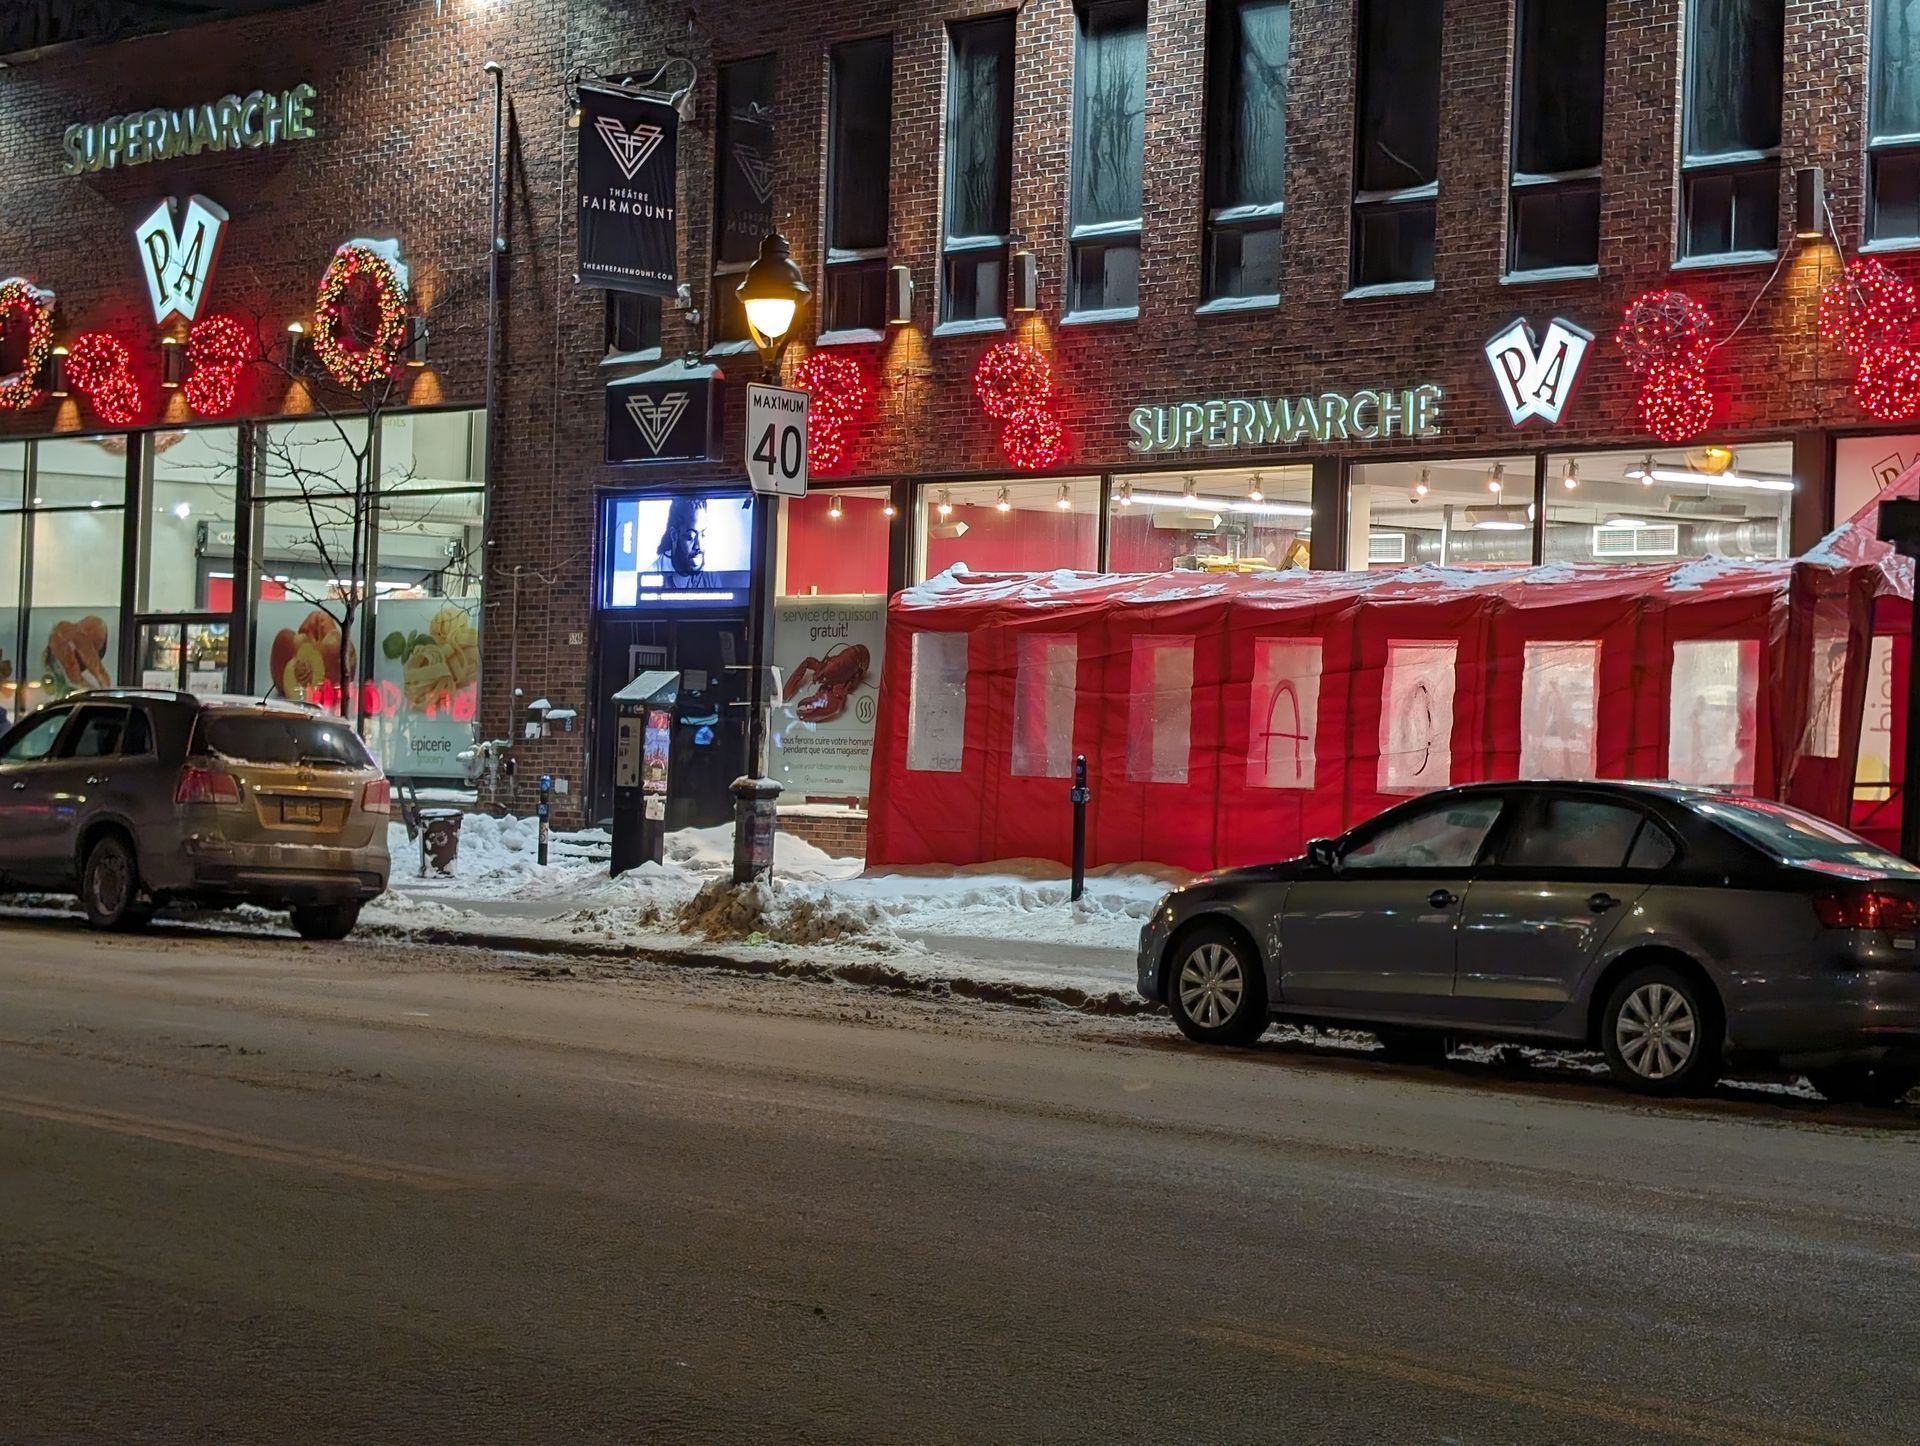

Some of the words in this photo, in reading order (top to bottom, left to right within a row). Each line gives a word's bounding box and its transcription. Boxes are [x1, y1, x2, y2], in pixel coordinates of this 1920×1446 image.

[582, 195, 674, 221] FAIRMOUNT
[145, 221, 207, 306] PA
[583, 262, 673, 281] THEATREFAIRMOUNT.COM
[1495, 340, 1569, 411] PA
[753, 393, 804, 413] MAXIMUM
[752, 423, 802, 479] 40
[783, 608, 820, 622] service
[822, 607, 836, 622] de
[838, 606, 879, 621] cuisson
[810, 623, 849, 641] gratuit!
[411, 736, 451, 755] épicerie
[815, 736, 830, 745] cuire
[831, 736, 848, 745] votre
[783, 746, 808, 755] pendant
[809, 747, 821, 756] que
[416, 755, 445, 768] grocery
